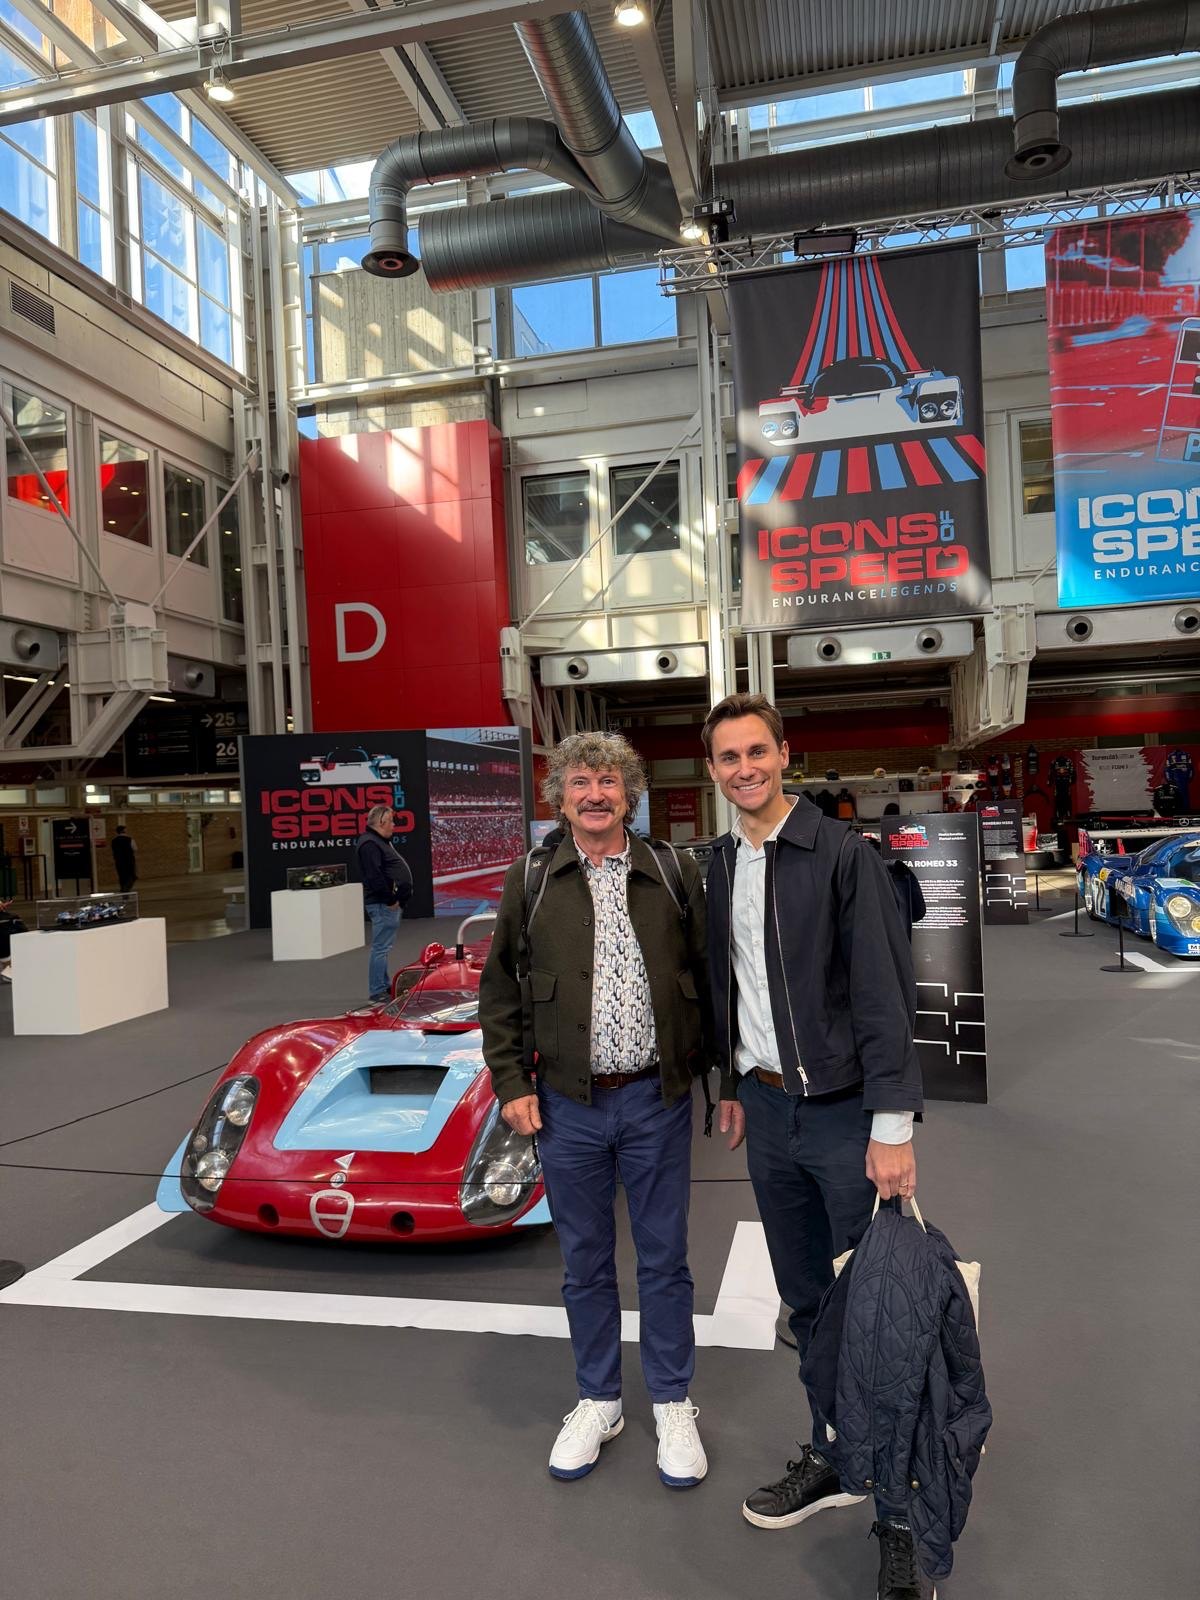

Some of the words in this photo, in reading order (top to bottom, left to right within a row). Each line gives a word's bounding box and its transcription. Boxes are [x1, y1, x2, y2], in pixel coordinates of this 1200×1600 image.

[758, 513, 938, 561] ICONS
[940, 510, 955, 542] OF
[771, 545, 970, 593] SPEED
[335, 602, 387, 662] D
[215, 712, 235, 727] 25
[216, 742, 237, 757] 26
[260, 786, 393, 815] ICONS
[394, 785, 405, 808] OF
[888, 833, 923, 841] ICONS
[914, 860, 945, 868] ROMEO
[946, 859, 958, 867] 33
